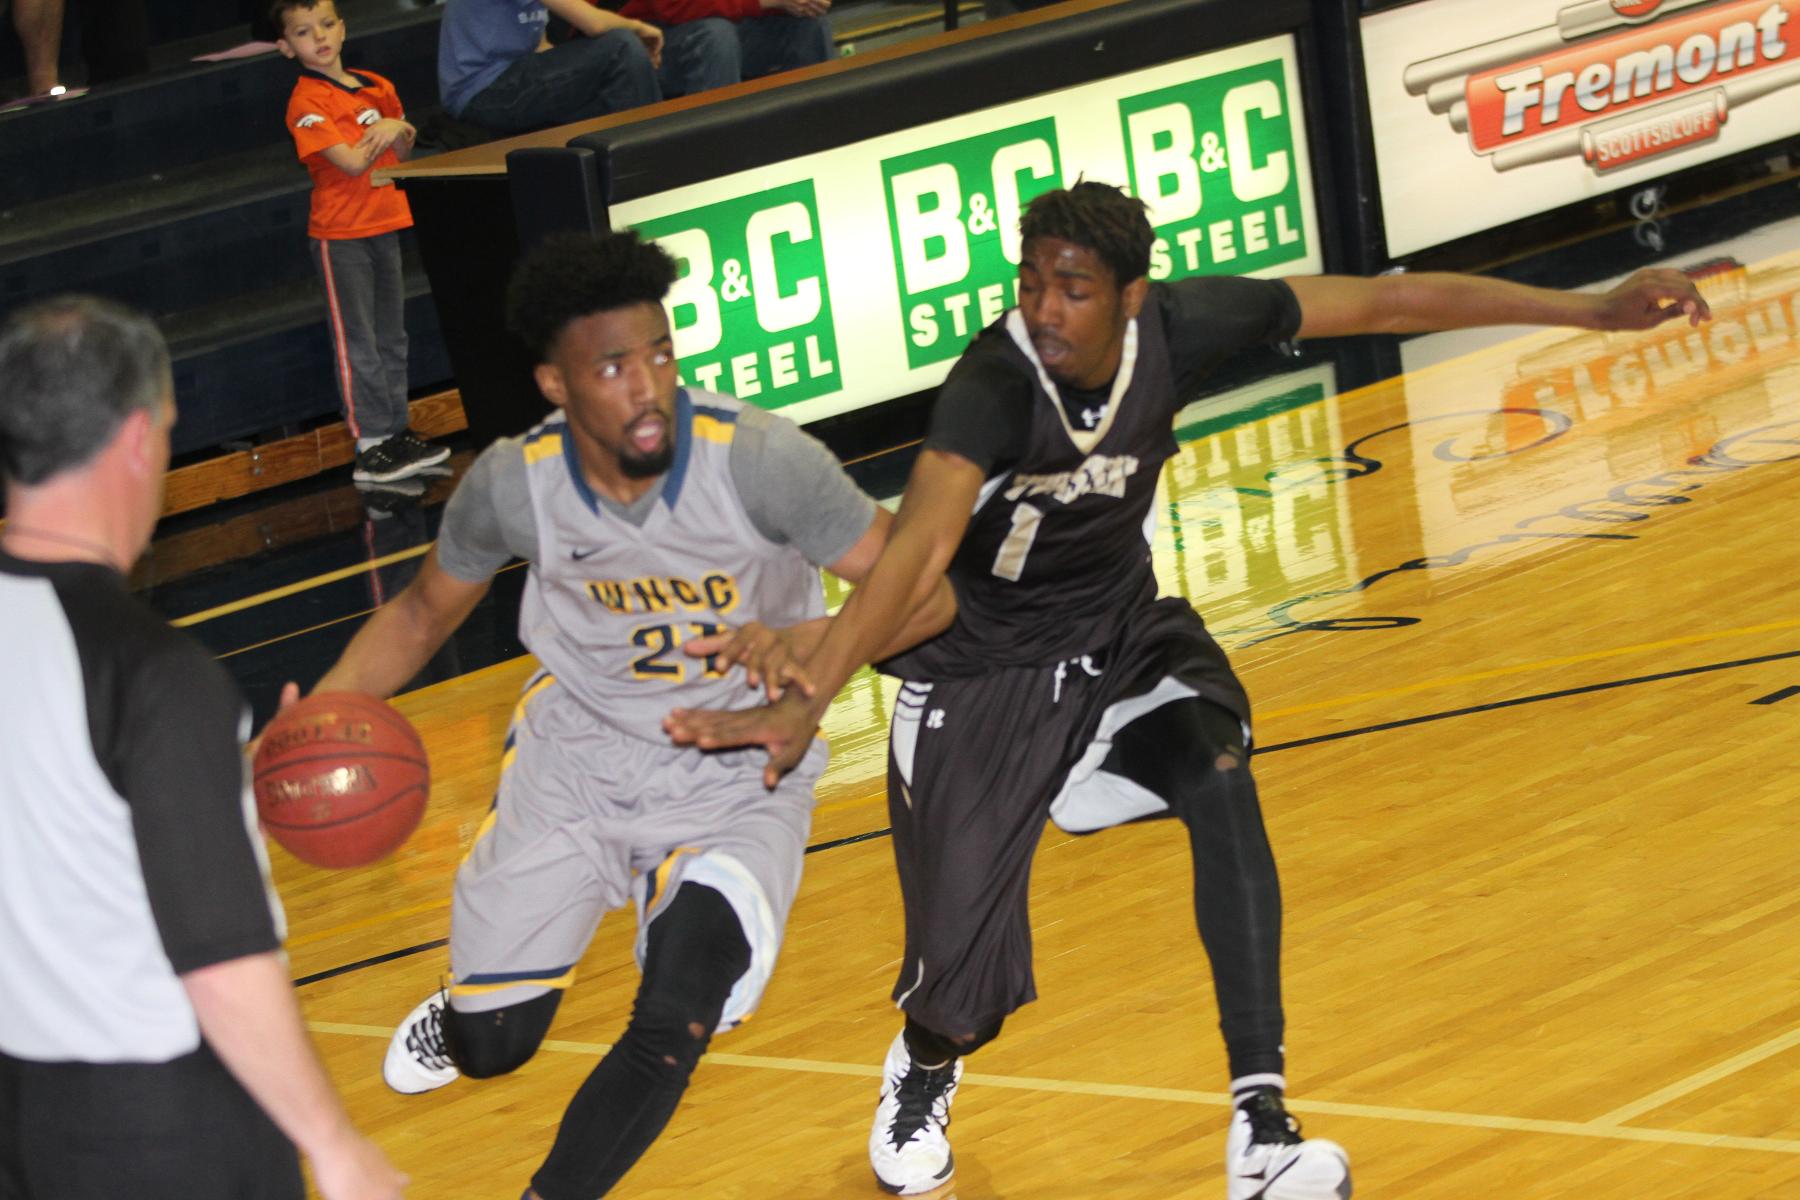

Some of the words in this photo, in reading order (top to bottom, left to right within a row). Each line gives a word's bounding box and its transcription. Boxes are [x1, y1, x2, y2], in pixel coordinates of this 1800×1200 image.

[1495, 3, 1790, 137] Fremont
[1128, 79, 1290, 229] B&C
[1149, 205, 1300, 280] STEEL
[909, 277, 1020, 348] STE
[676, 334, 834, 400] TEEL
[992, 502, 1045, 582] 1
